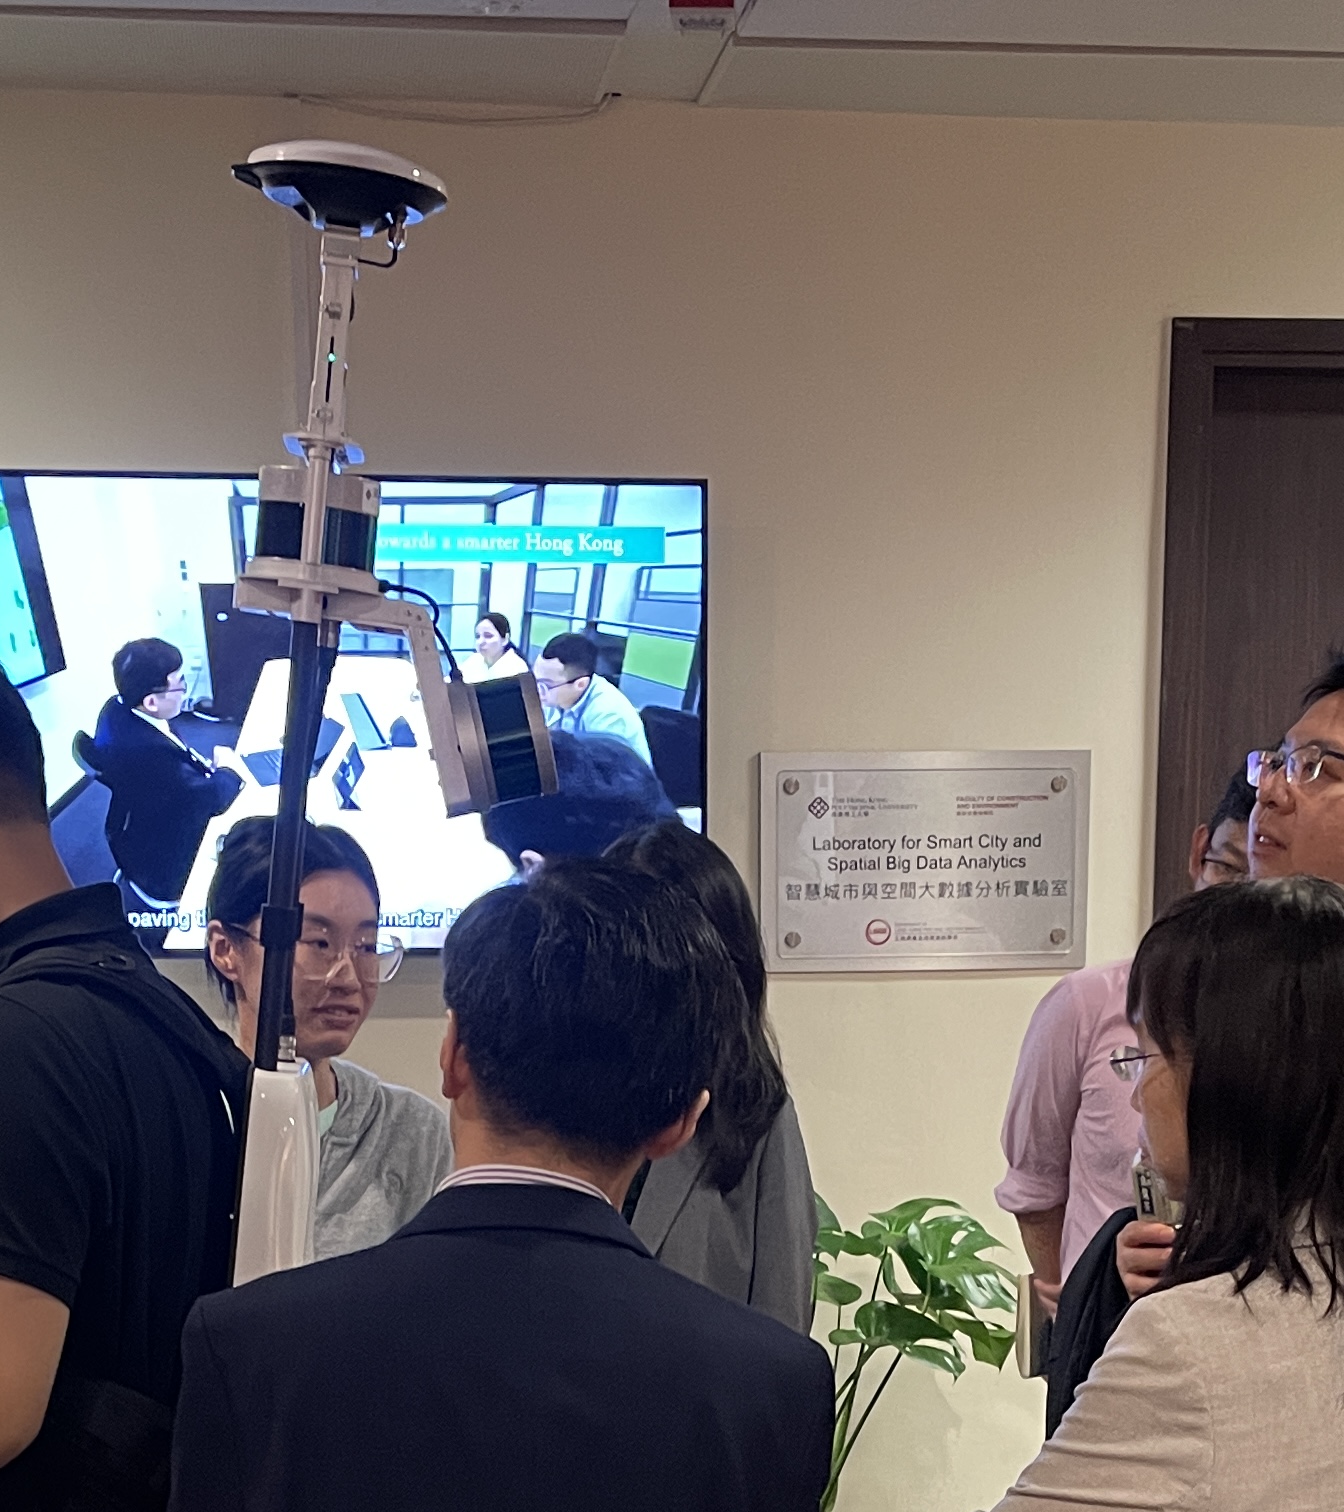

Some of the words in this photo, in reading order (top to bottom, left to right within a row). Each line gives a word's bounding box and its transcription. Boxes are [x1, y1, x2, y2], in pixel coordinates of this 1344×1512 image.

[377, 531, 436, 549] owards
[456, 534, 520, 551] smarter
[525, 532, 573, 557] Hong
[578, 532, 624, 557] Kong
[812, 836, 897, 853] Laboratory
[901, 835, 922, 850] for
[926, 834, 973, 850] Smart
[978, 833, 1008, 851] City
[1012, 833, 1042, 849] and
[827, 856, 881, 874] Spatial
[886, 855, 911, 873] Big
[916, 855, 953, 870] Data
[956, 854, 1027, 873] Analytics
